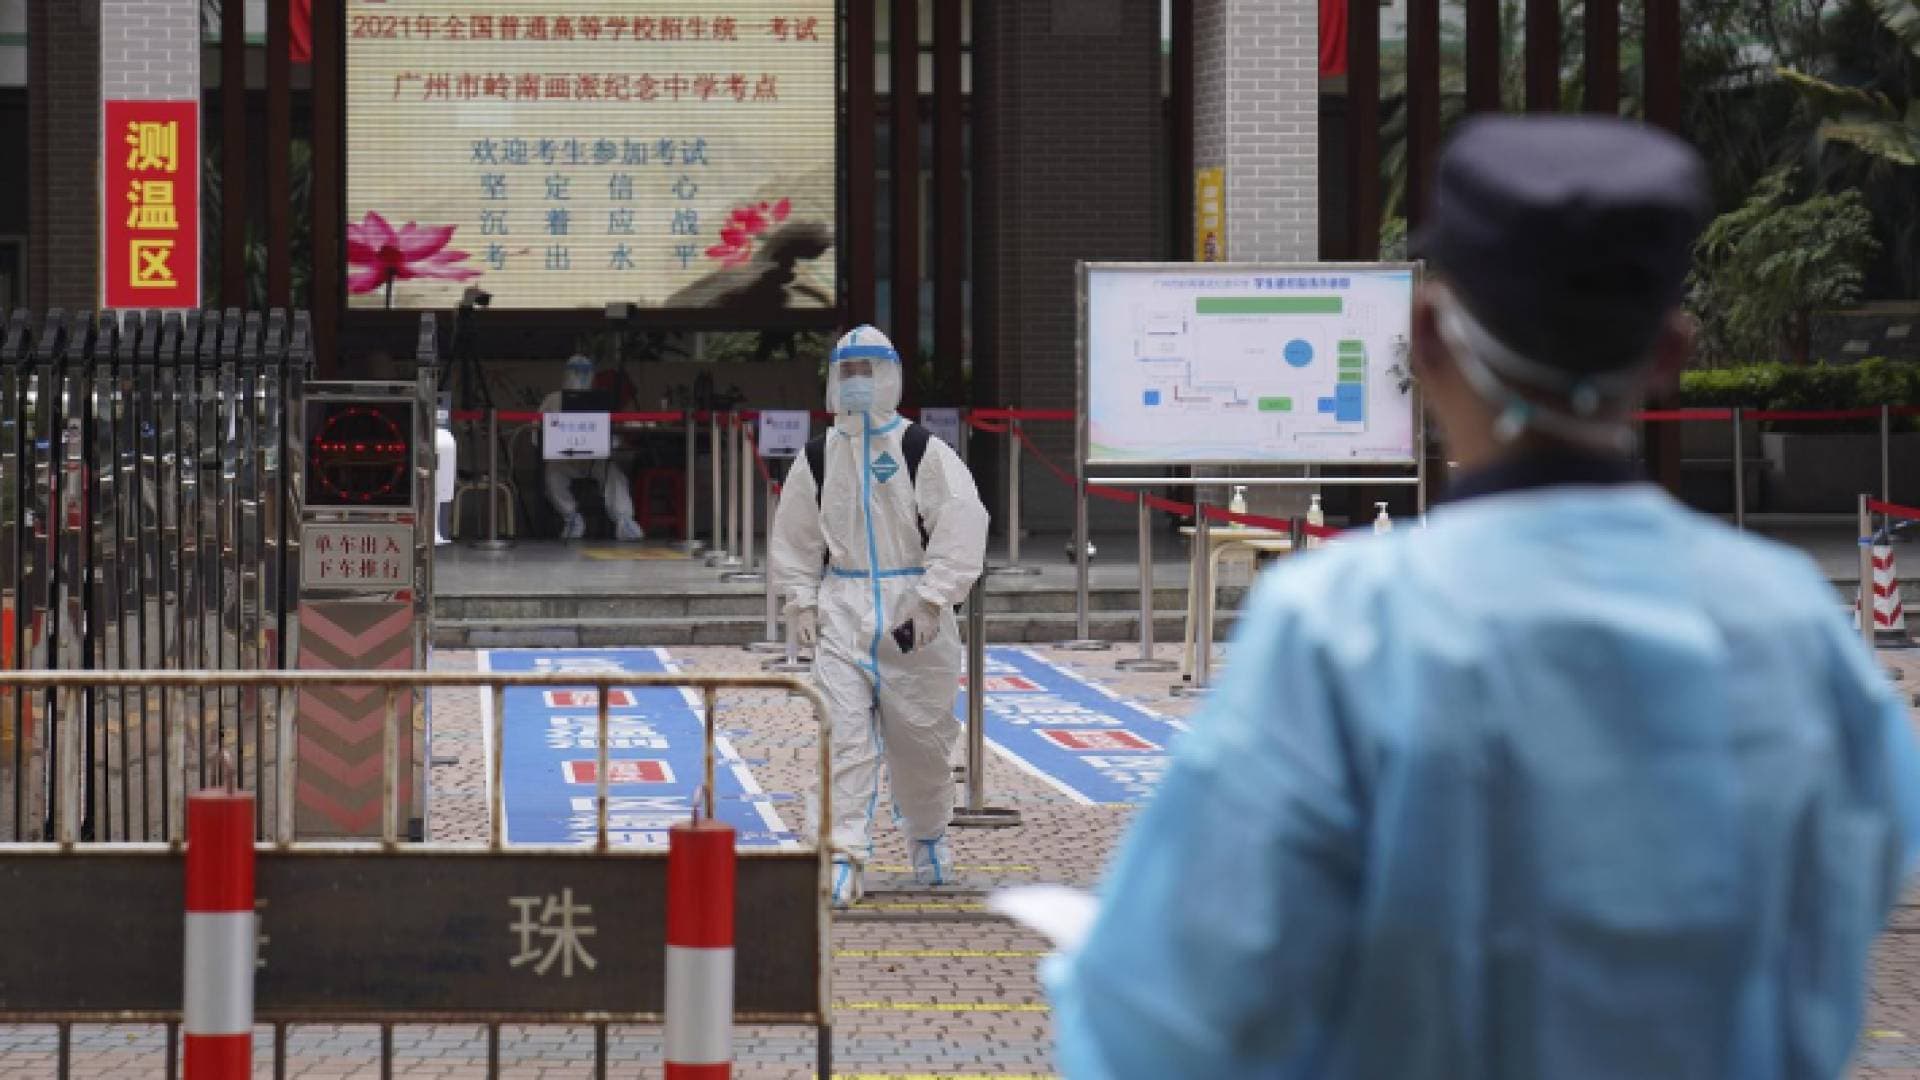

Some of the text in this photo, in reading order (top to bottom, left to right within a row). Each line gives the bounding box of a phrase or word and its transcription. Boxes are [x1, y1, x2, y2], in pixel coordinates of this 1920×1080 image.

[470, 137, 708, 165] 欢迎考生参加考试
[125, 120, 179, 288] 测温区
[315, 534, 401, 555] 单车出入
[318, 557, 400, 579] 下车推行
[509, 887, 598, 977] 珠
